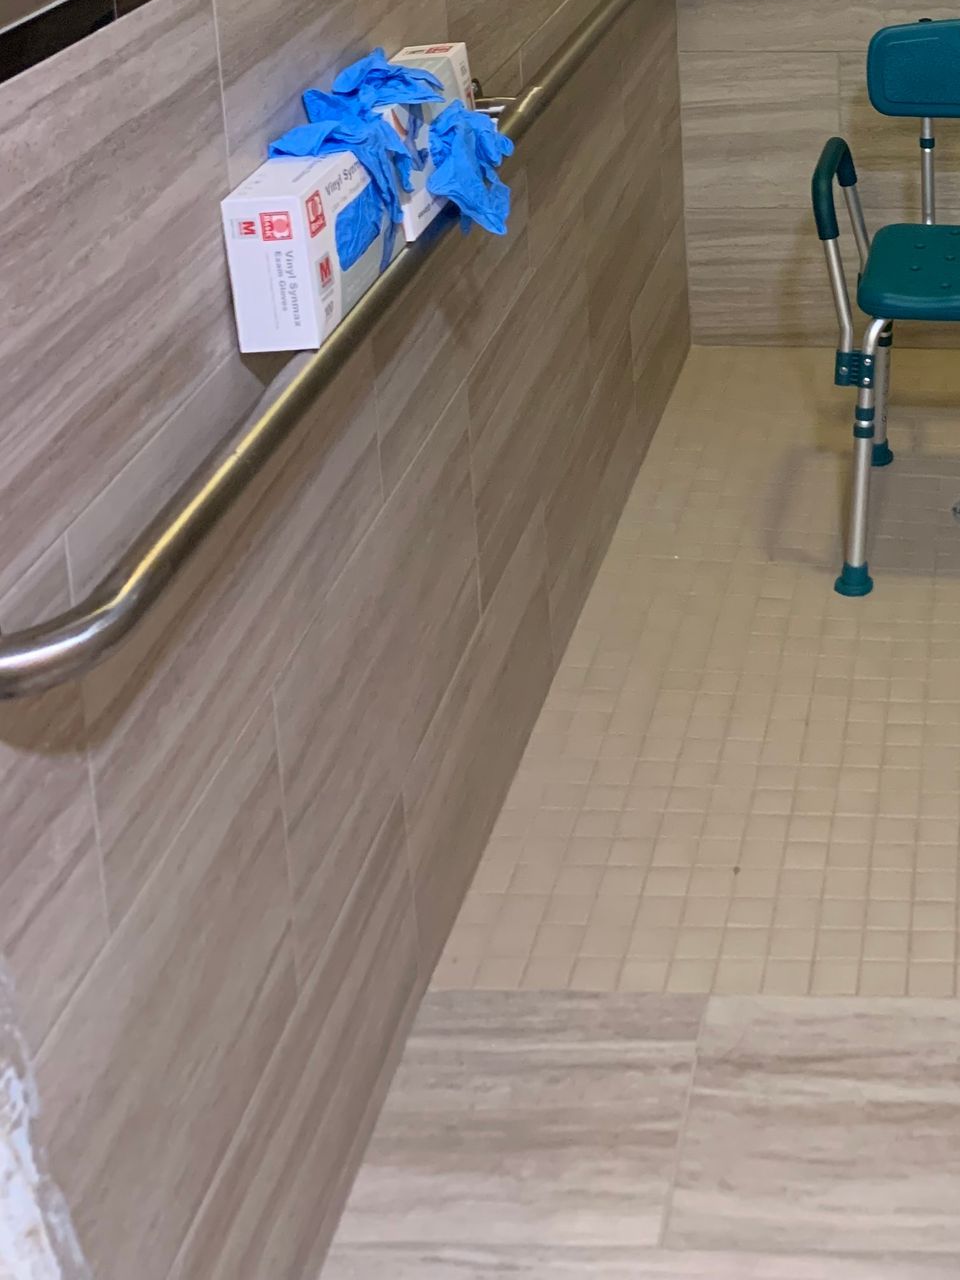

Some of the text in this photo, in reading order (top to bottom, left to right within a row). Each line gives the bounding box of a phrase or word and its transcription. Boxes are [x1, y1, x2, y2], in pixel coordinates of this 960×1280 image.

[242, 221, 256, 235] M
[285, 250, 297, 279] Vinyl
[274, 250, 288, 312] Exam Gloves
